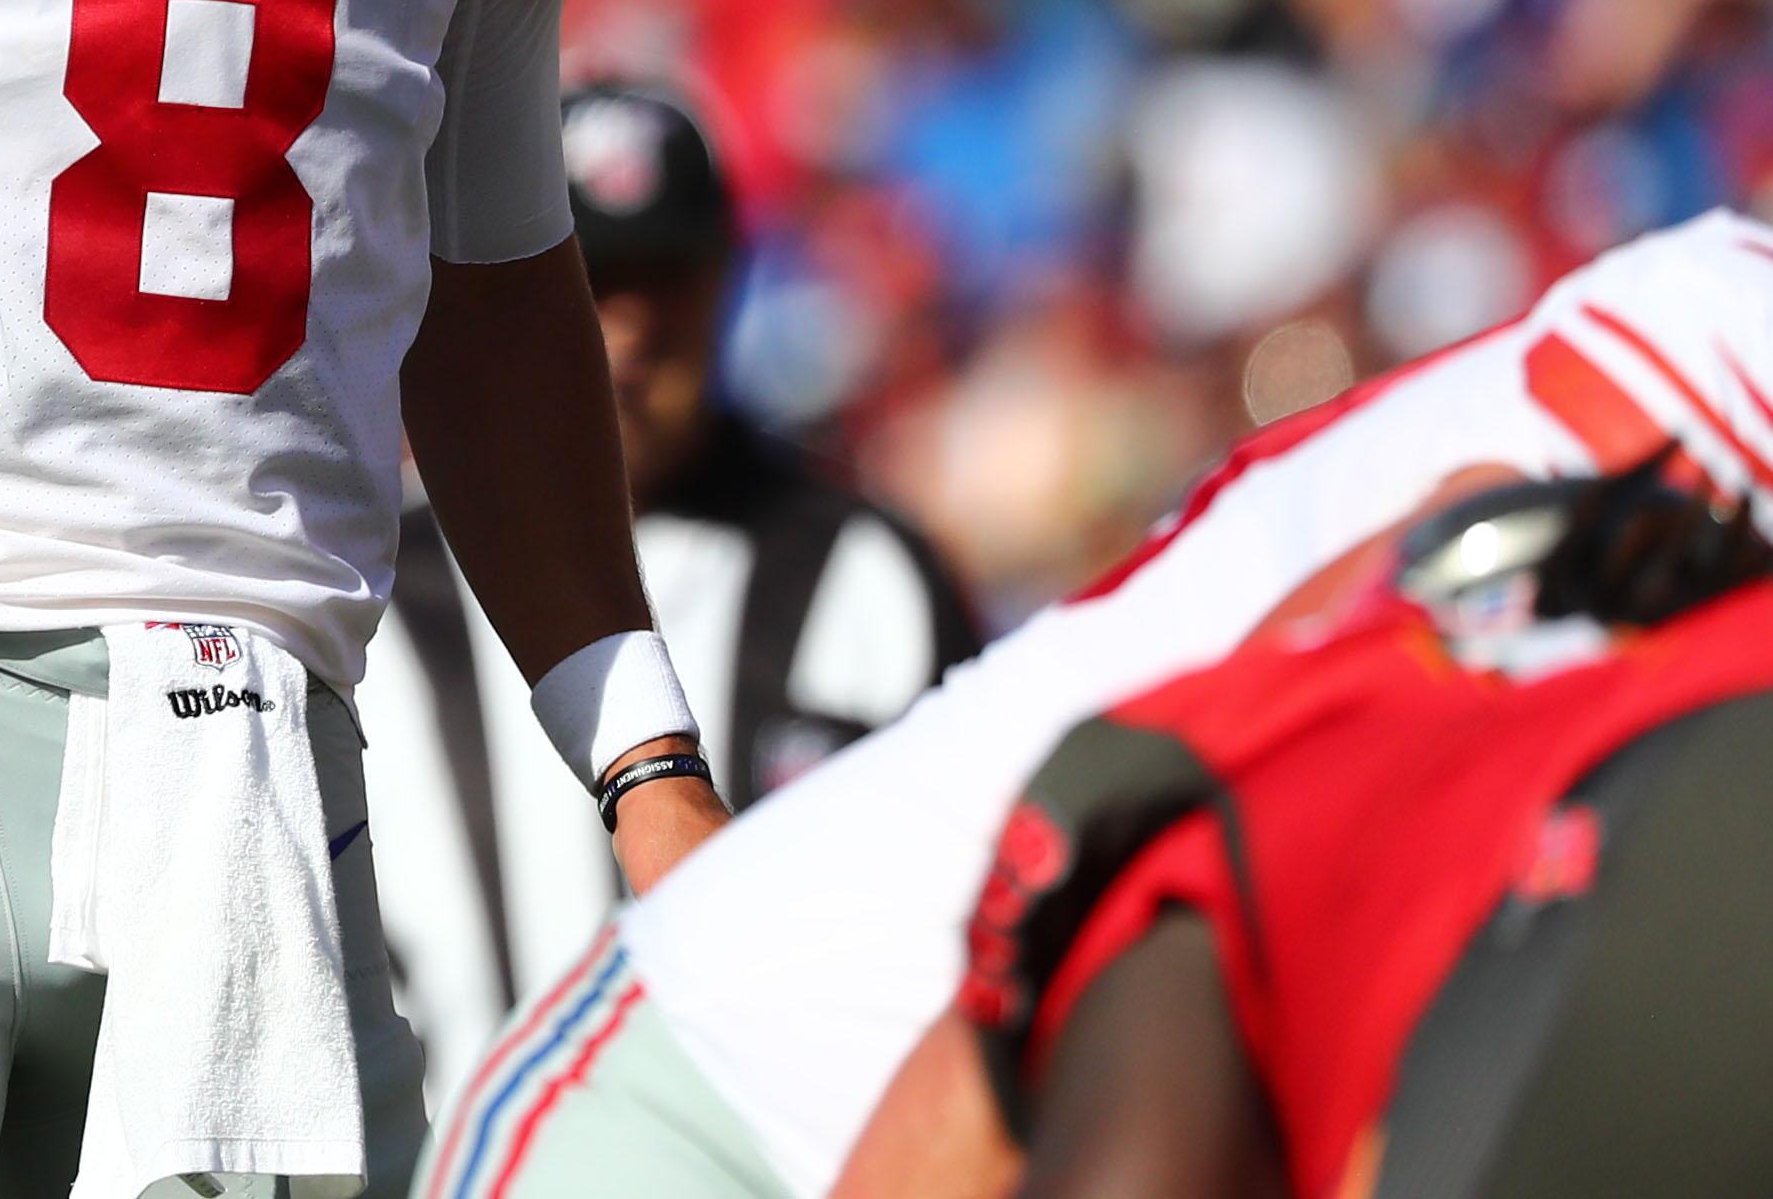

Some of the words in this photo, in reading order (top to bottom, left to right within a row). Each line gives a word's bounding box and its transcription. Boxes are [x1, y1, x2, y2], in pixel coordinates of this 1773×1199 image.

[198, 638, 236, 665] NFL
[166, 684, 263, 719] Wilson
[616, 759, 674, 789] ASSIGNMENT
